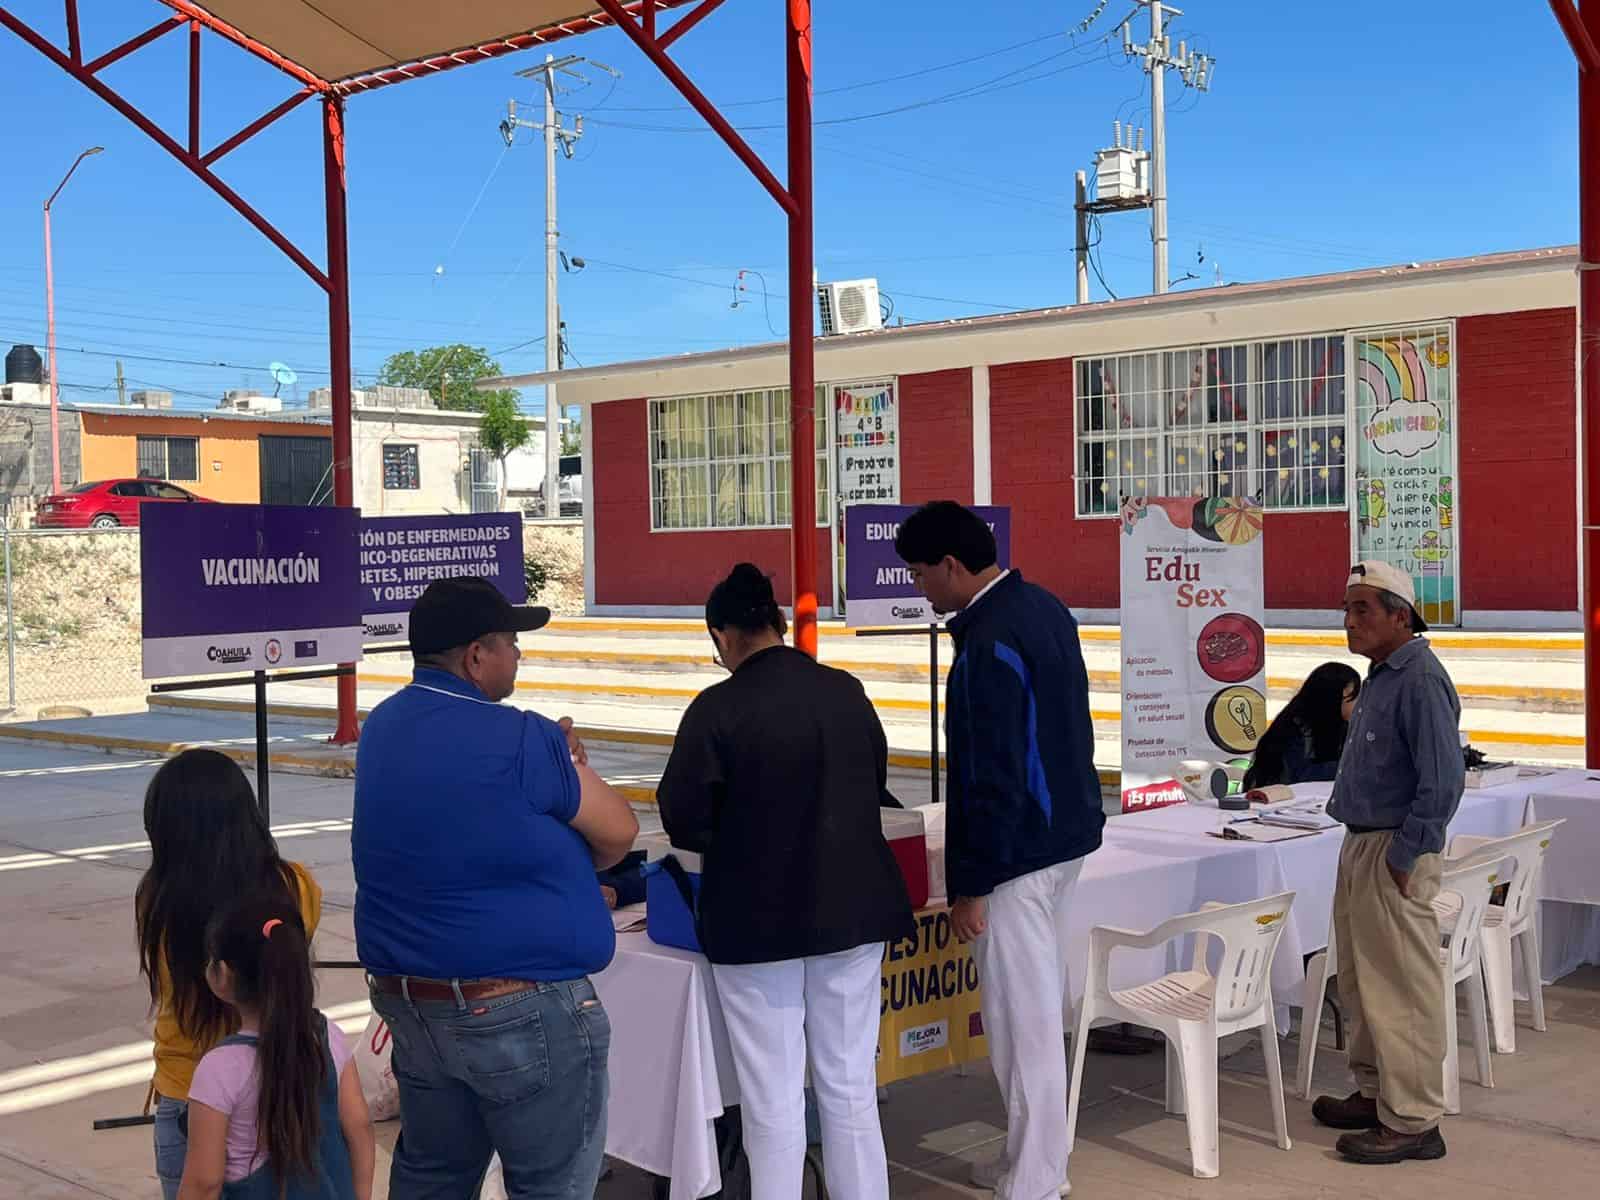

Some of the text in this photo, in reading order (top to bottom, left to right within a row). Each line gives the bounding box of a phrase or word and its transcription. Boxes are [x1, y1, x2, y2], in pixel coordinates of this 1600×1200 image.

[387, 530, 405, 546] DE
[407, 526, 510, 545] ENFERMEDADES
[201, 551, 320, 586] VACUNACIÓN
[404, 560, 500, 582] HIPERTENSIÓN
[1144, 555, 1201, 582] Edu
[372, 587, 382, 601] Y
[1176, 583, 1228, 608] Sex
[207, 646, 252, 661] COAHUILA
[907, 1026, 942, 1043] MEJORA
